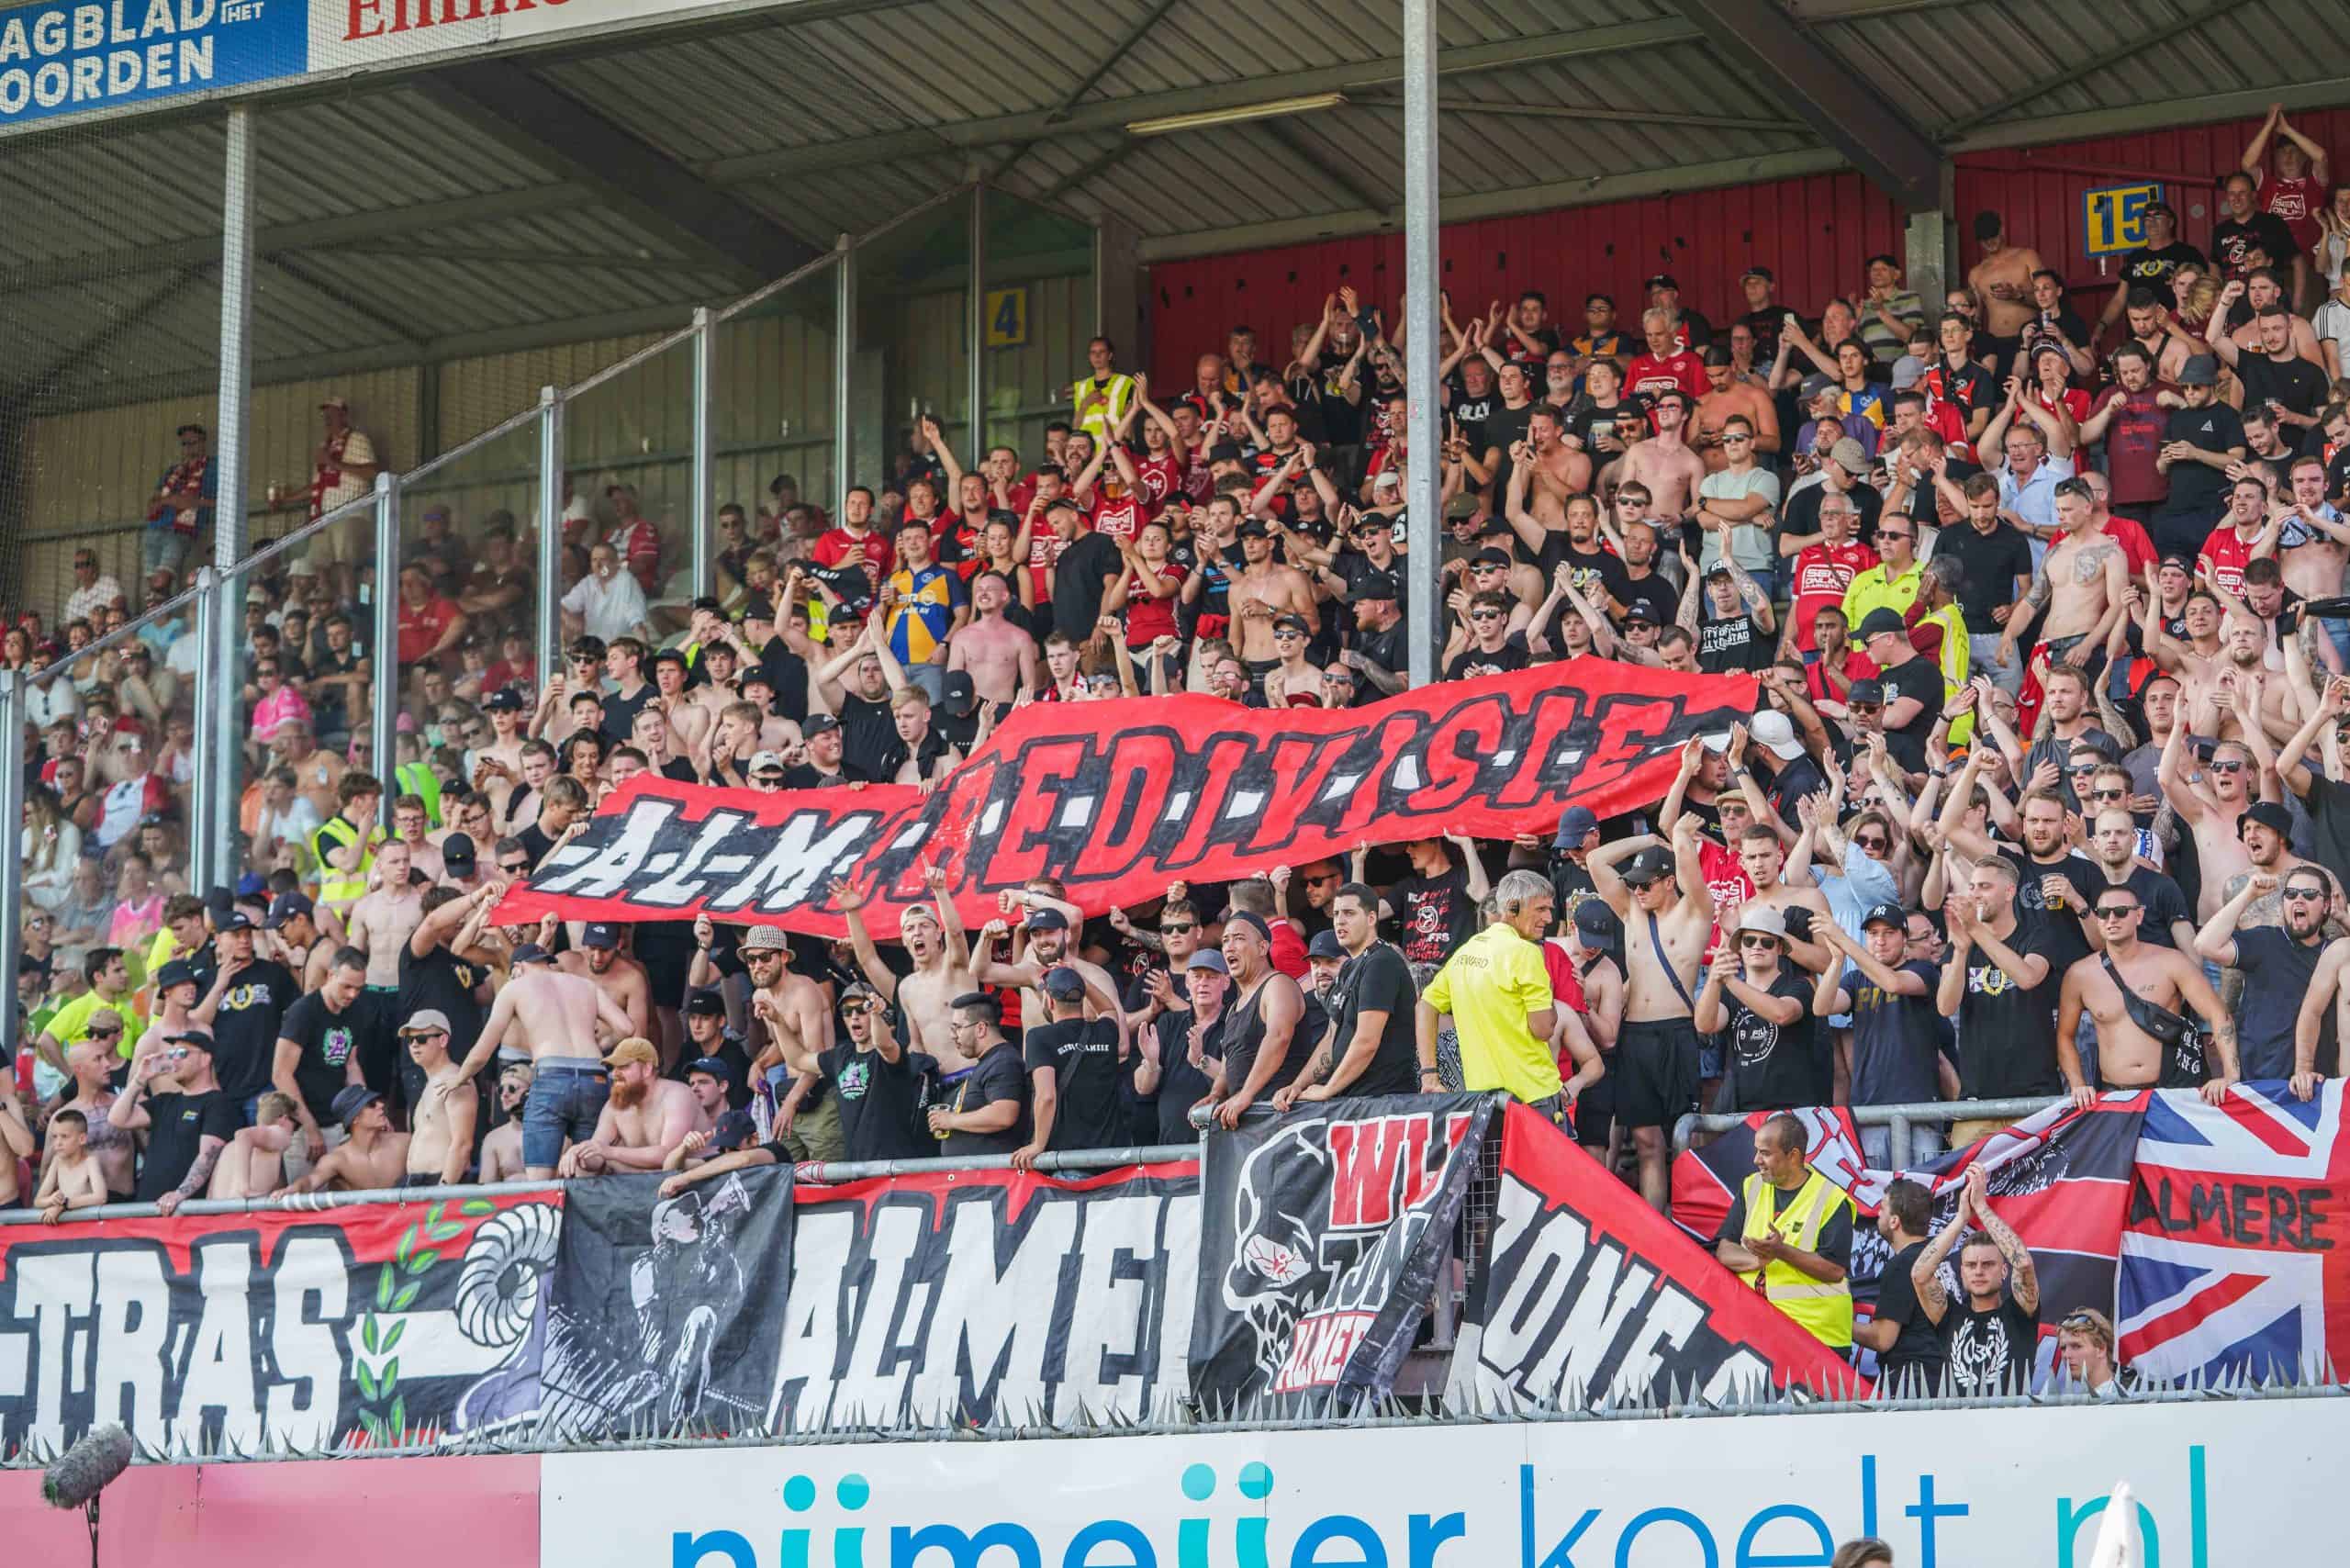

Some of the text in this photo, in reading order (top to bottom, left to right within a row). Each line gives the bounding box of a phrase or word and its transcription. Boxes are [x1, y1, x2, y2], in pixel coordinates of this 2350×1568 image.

[0, 35, 214, 114] OORDEN
[2094, 190, 2150, 245] 15
[994, 293, 1021, 340] 4
[2217, 574, 2247, 586] SEN
[2129, 1173, 2335, 1250] ALMERE
